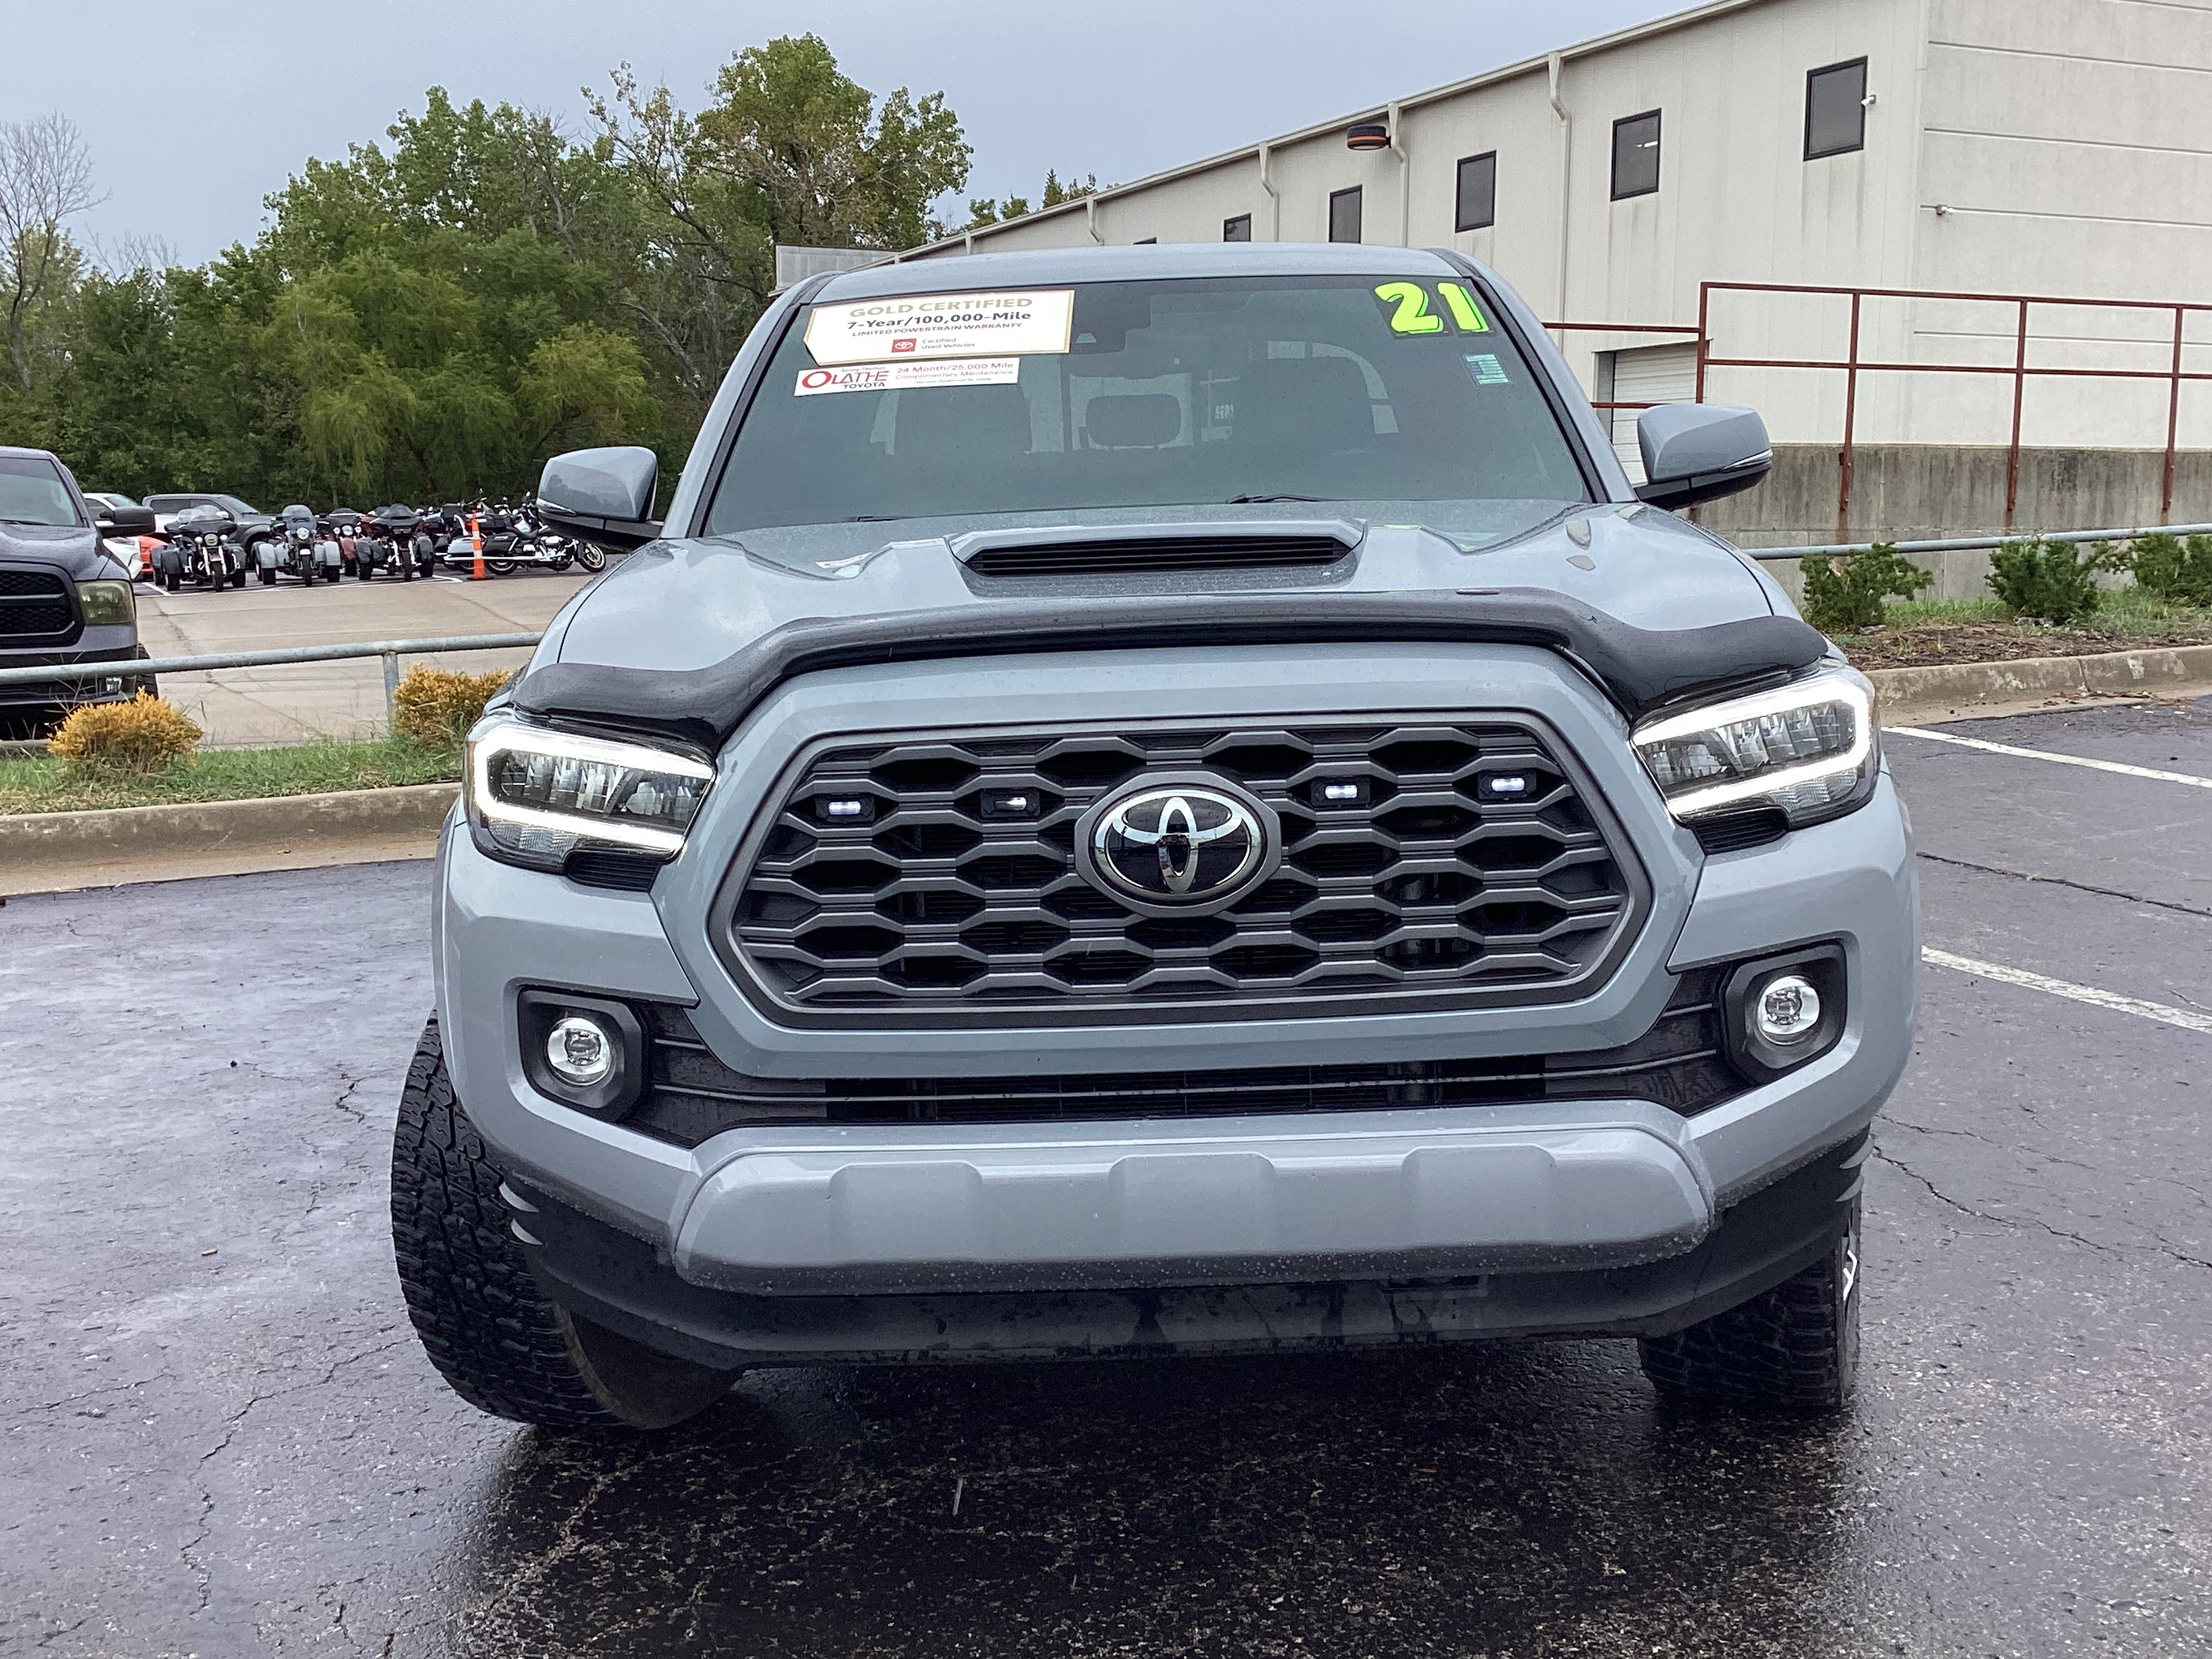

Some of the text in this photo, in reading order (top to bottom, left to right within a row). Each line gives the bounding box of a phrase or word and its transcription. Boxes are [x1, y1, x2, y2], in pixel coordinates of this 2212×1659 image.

[850, 298, 1033, 317] GOLD CERTIFIED
[1374, 281, 1489, 333] 21
[847, 311, 1031, 329] 7-Year/100,000-Mile
[852, 322, 1022, 337] LIMITED POWERTRAIN WARRANTY
[802, 370, 890, 388] OLATHE
[842, 382, 885, 390] TOYOTA
